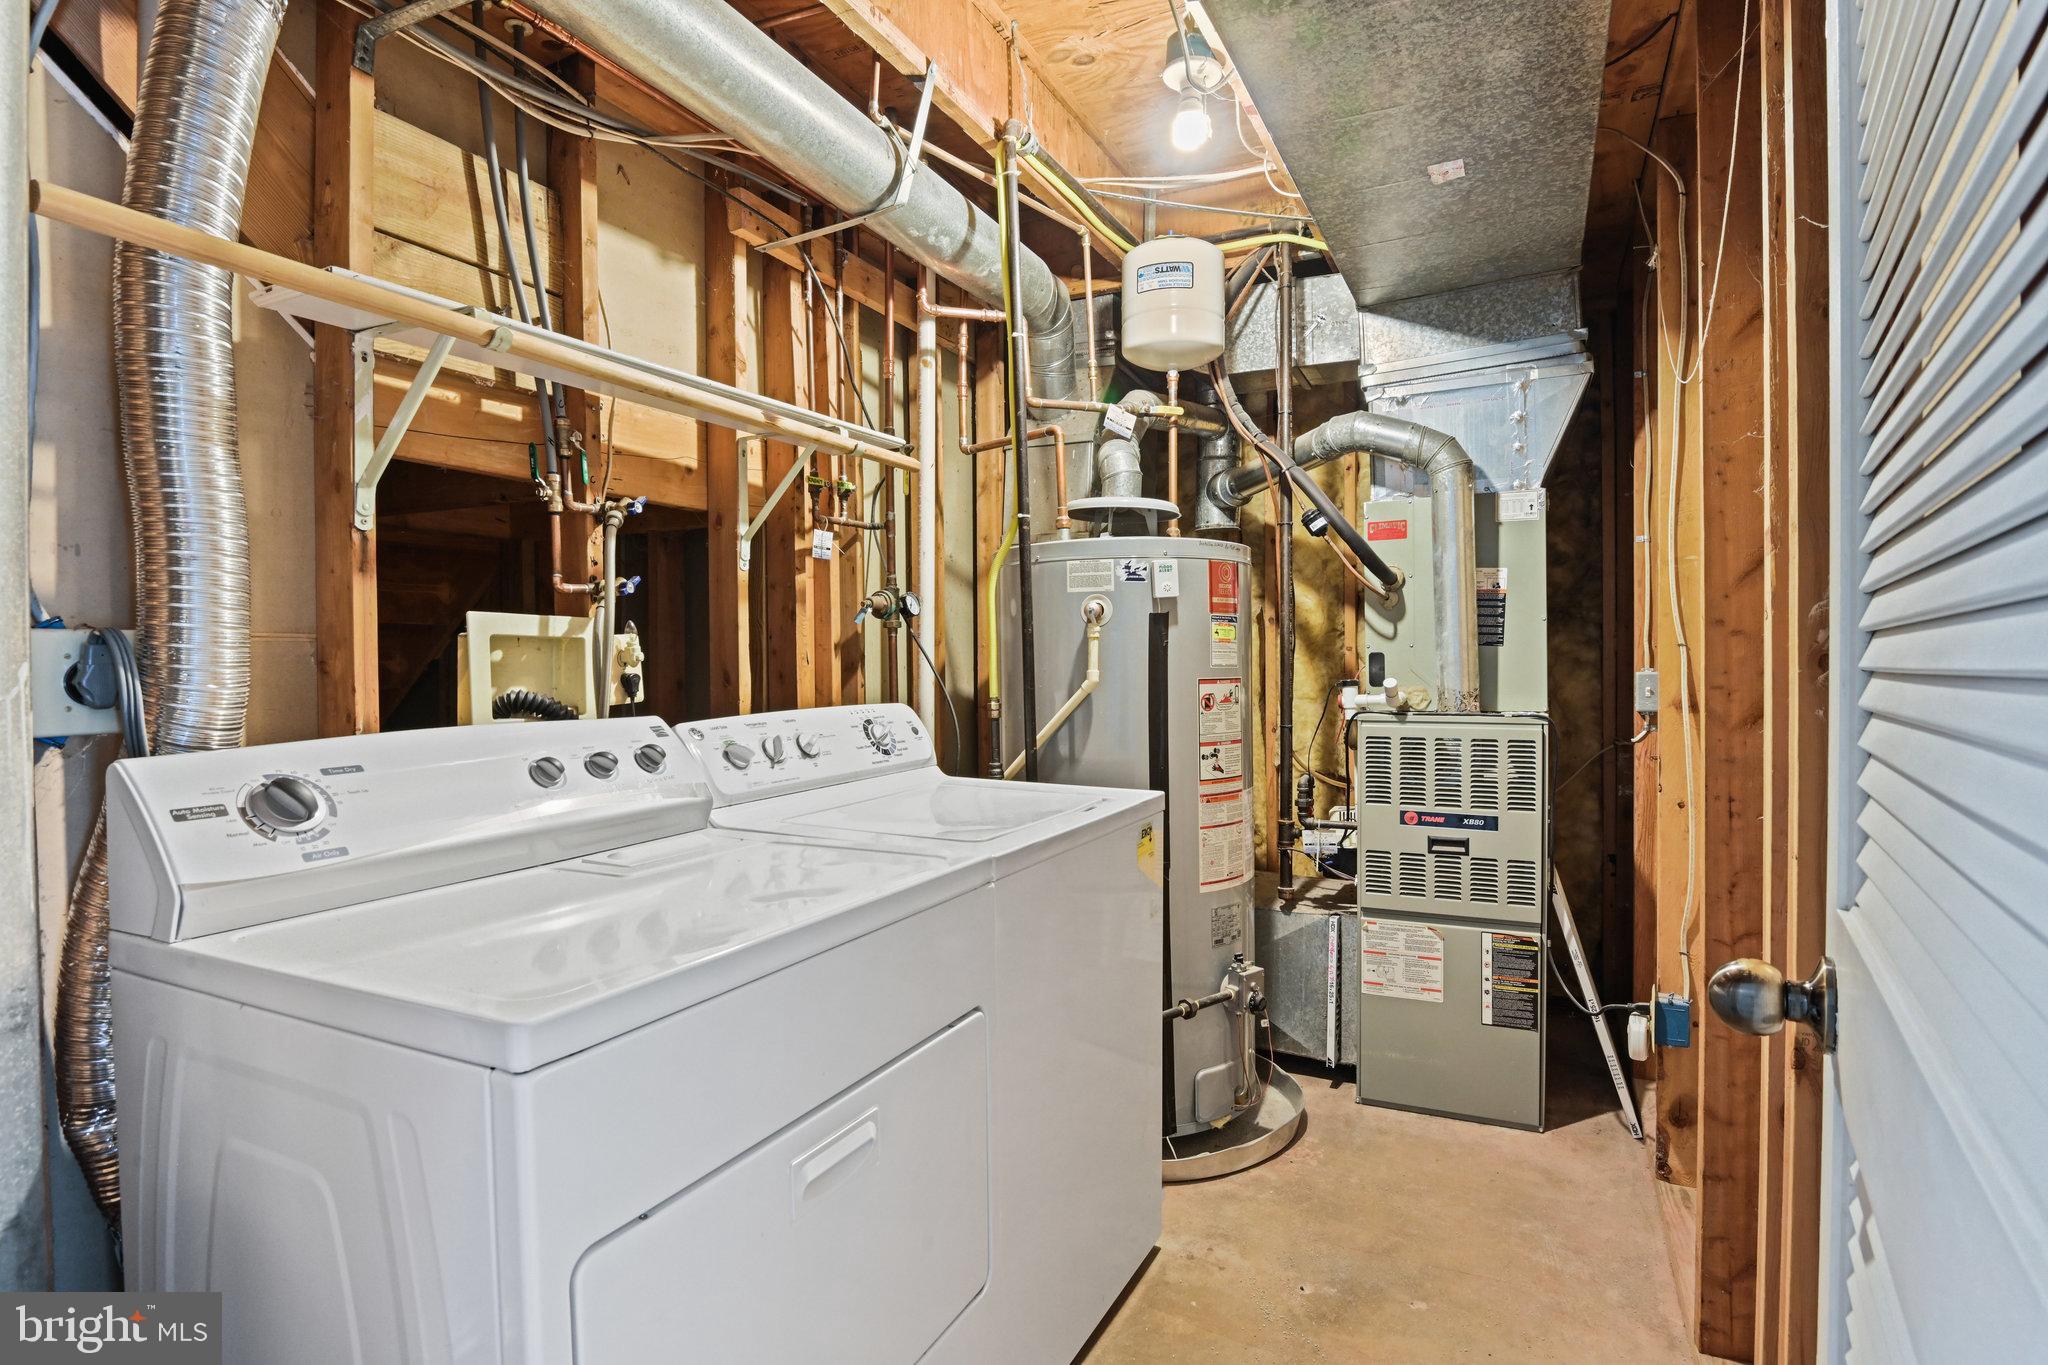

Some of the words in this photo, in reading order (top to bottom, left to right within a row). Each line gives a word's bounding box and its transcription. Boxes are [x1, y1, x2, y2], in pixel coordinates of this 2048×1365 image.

[1154, 266, 1180, 274] WATTS
[172, 808, 191, 816] Auto
[192, 805, 225, 814] Moisture
[186, 811, 216, 820] Sensing
